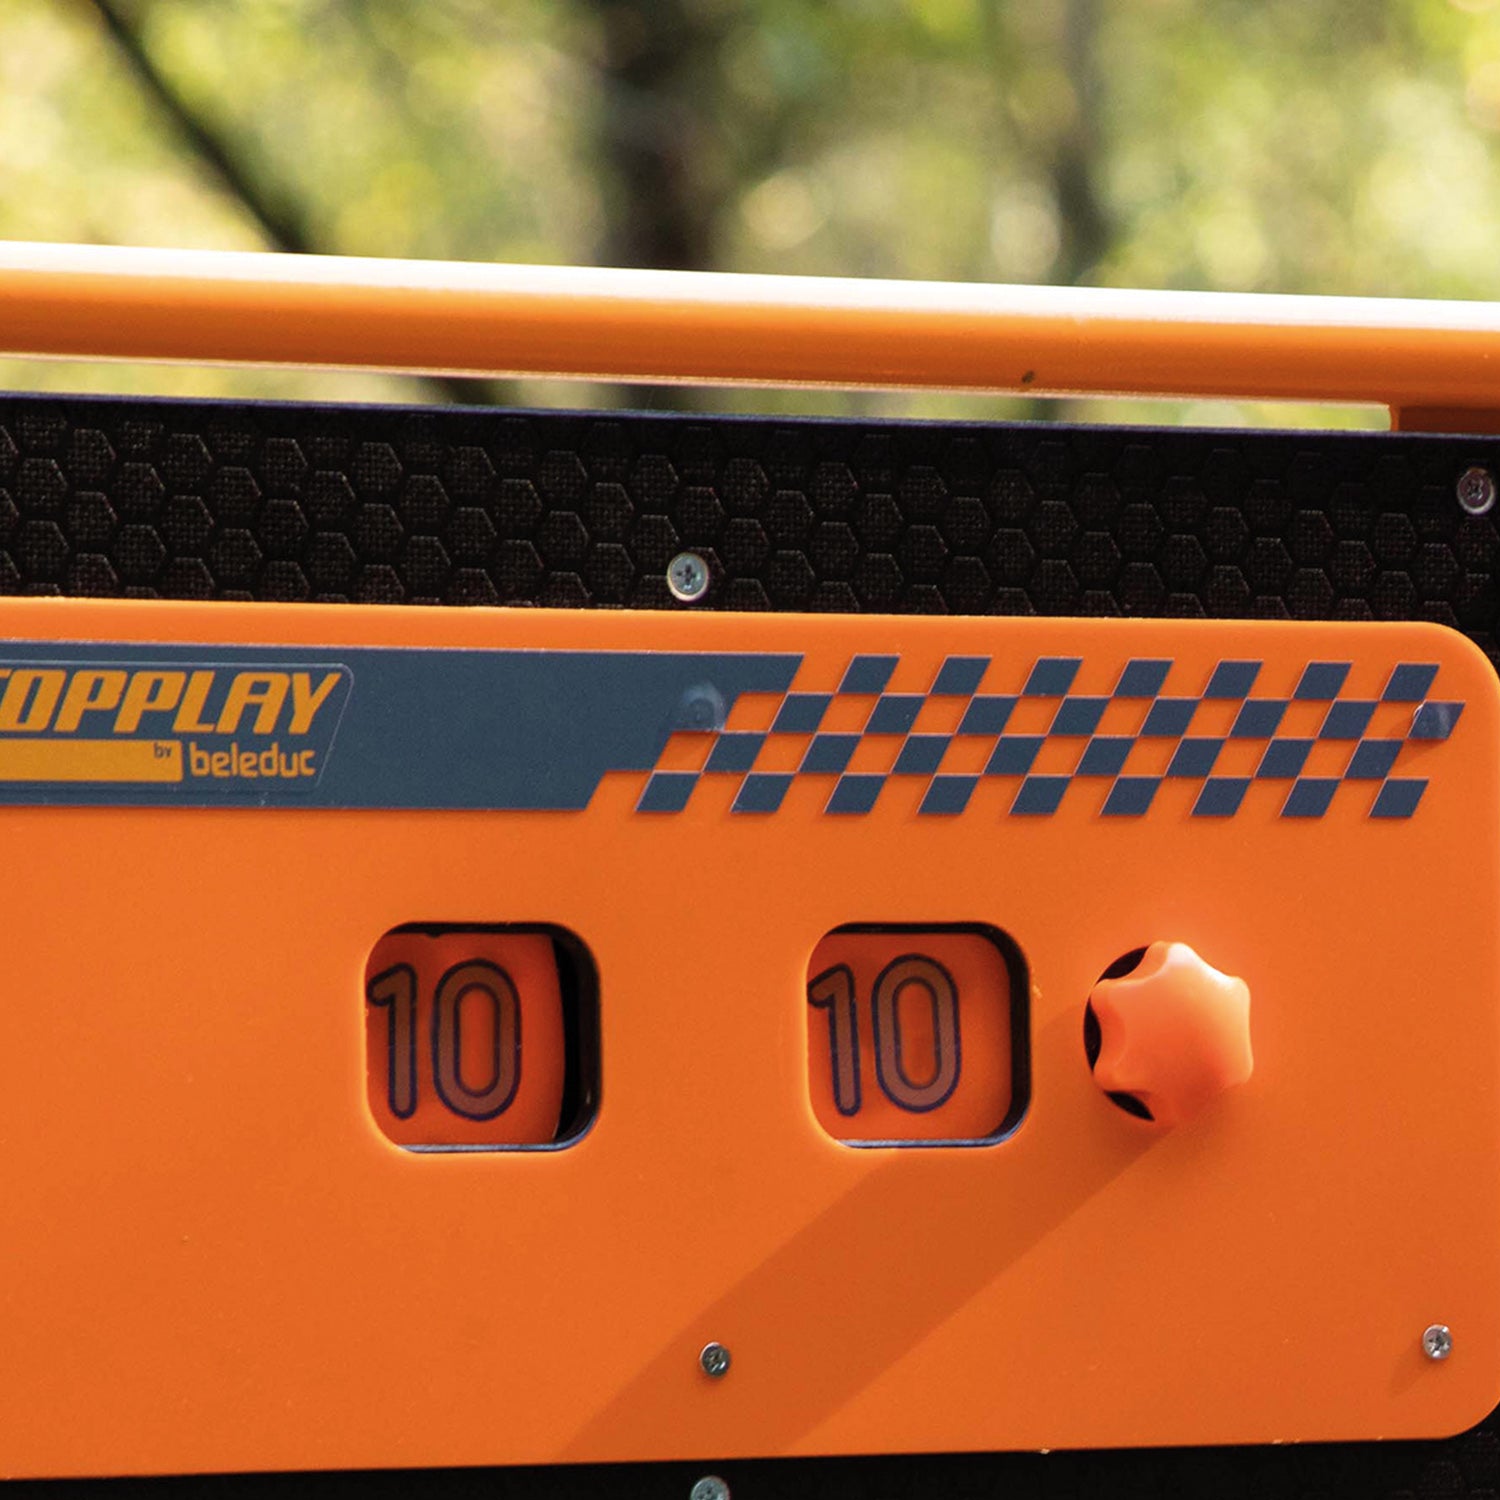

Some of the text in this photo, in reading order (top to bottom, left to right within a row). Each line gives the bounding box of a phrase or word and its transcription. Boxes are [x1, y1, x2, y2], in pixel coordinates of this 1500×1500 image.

[0, 668, 342, 735] OPPLAY
[189, 741, 316, 778] beleduc
[367, 959, 522, 1120] 10
[807, 953, 961, 1115] 10
